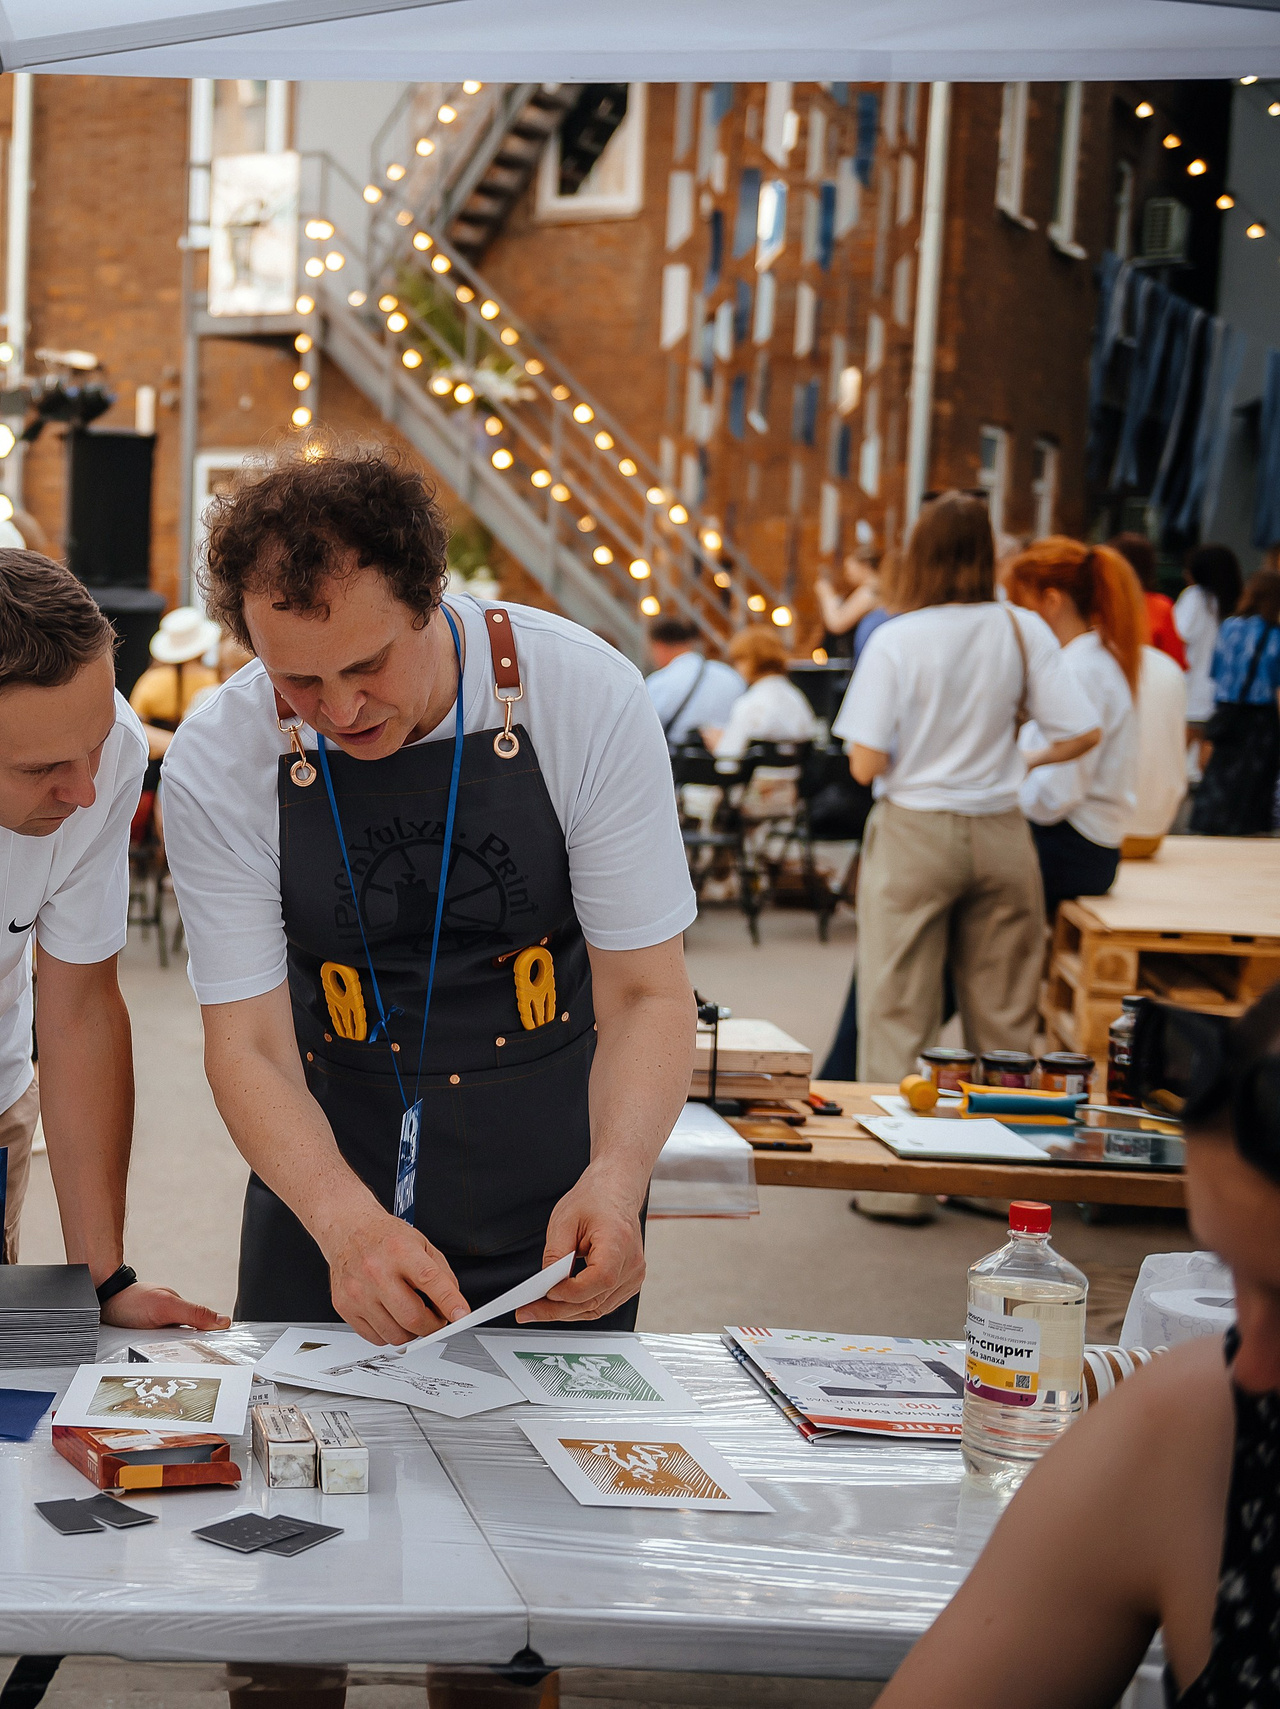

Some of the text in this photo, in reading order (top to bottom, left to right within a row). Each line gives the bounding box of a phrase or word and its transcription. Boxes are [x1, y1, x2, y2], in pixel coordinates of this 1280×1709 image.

[980, 1353, 1006, 1365] запаха
[834, 1406, 891, 1415] БУМАГА
[906, 1402, 942, 1410] 100
